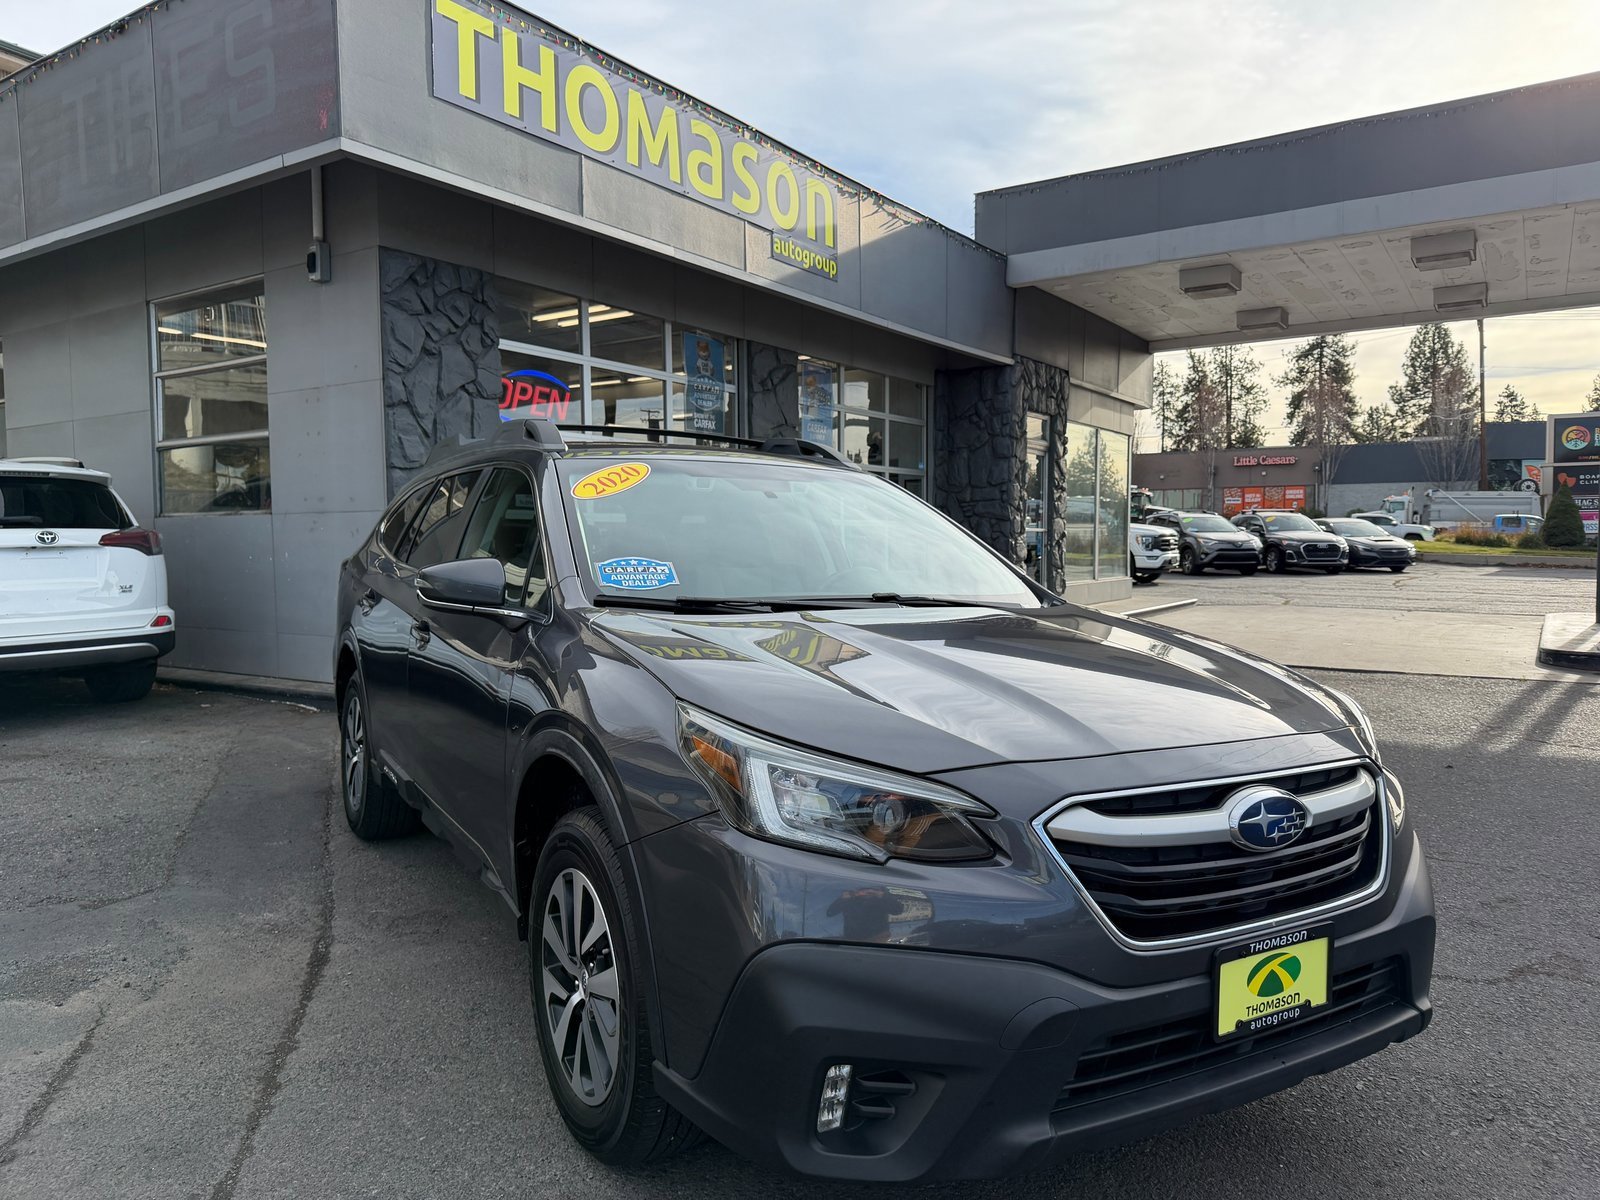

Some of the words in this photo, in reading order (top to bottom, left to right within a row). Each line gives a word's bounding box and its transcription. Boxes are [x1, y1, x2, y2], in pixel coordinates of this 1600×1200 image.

[773, 237, 837, 279] autogroup
[693, 419, 717, 430] CARFAX
[1233, 456, 1258, 467] Little
[1260, 455, 1296, 465] Caesars
[583, 465, 641, 496] 2020
[603, 566, 669, 574] CARFAX
[611, 573, 667, 581] ADVANTAGE
[622, 579, 659, 587] DEALER
[1250, 1007, 1301, 1030] autogroup
